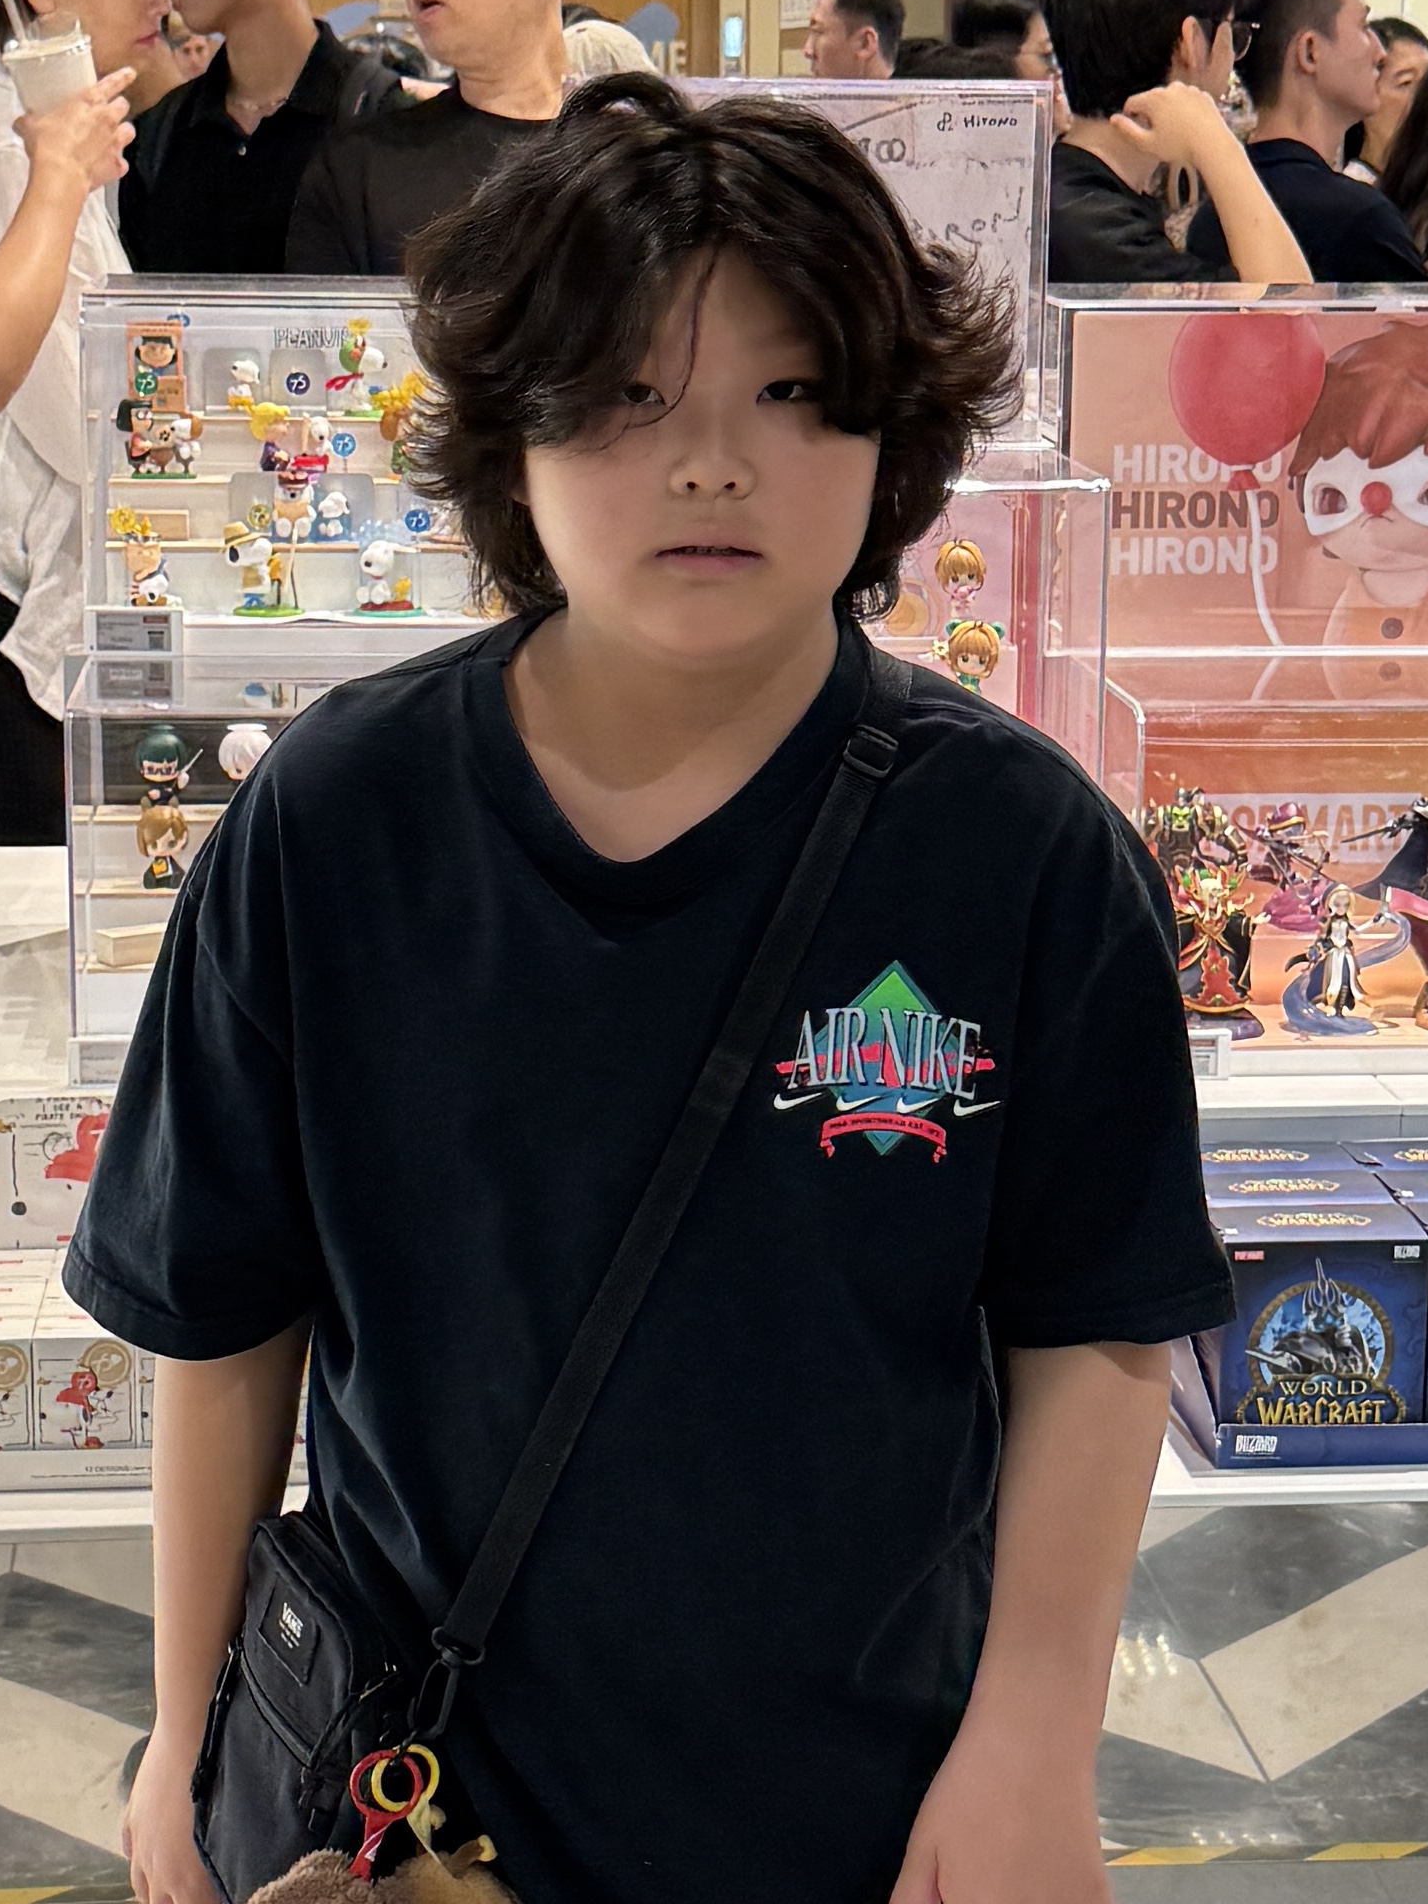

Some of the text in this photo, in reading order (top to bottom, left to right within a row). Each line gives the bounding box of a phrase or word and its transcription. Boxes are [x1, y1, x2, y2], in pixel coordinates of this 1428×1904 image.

[1112, 444, 1282, 484] HIROO
[1111, 490, 1280, 530] HIRONO
[1110, 536, 1279, 577] HIRONO
[787, 1007, 982, 1100] AIR NIKE
[1279, 1378, 1368, 1396] WORLD
[1257, 1396, 1387, 1425] WARCRAFT
